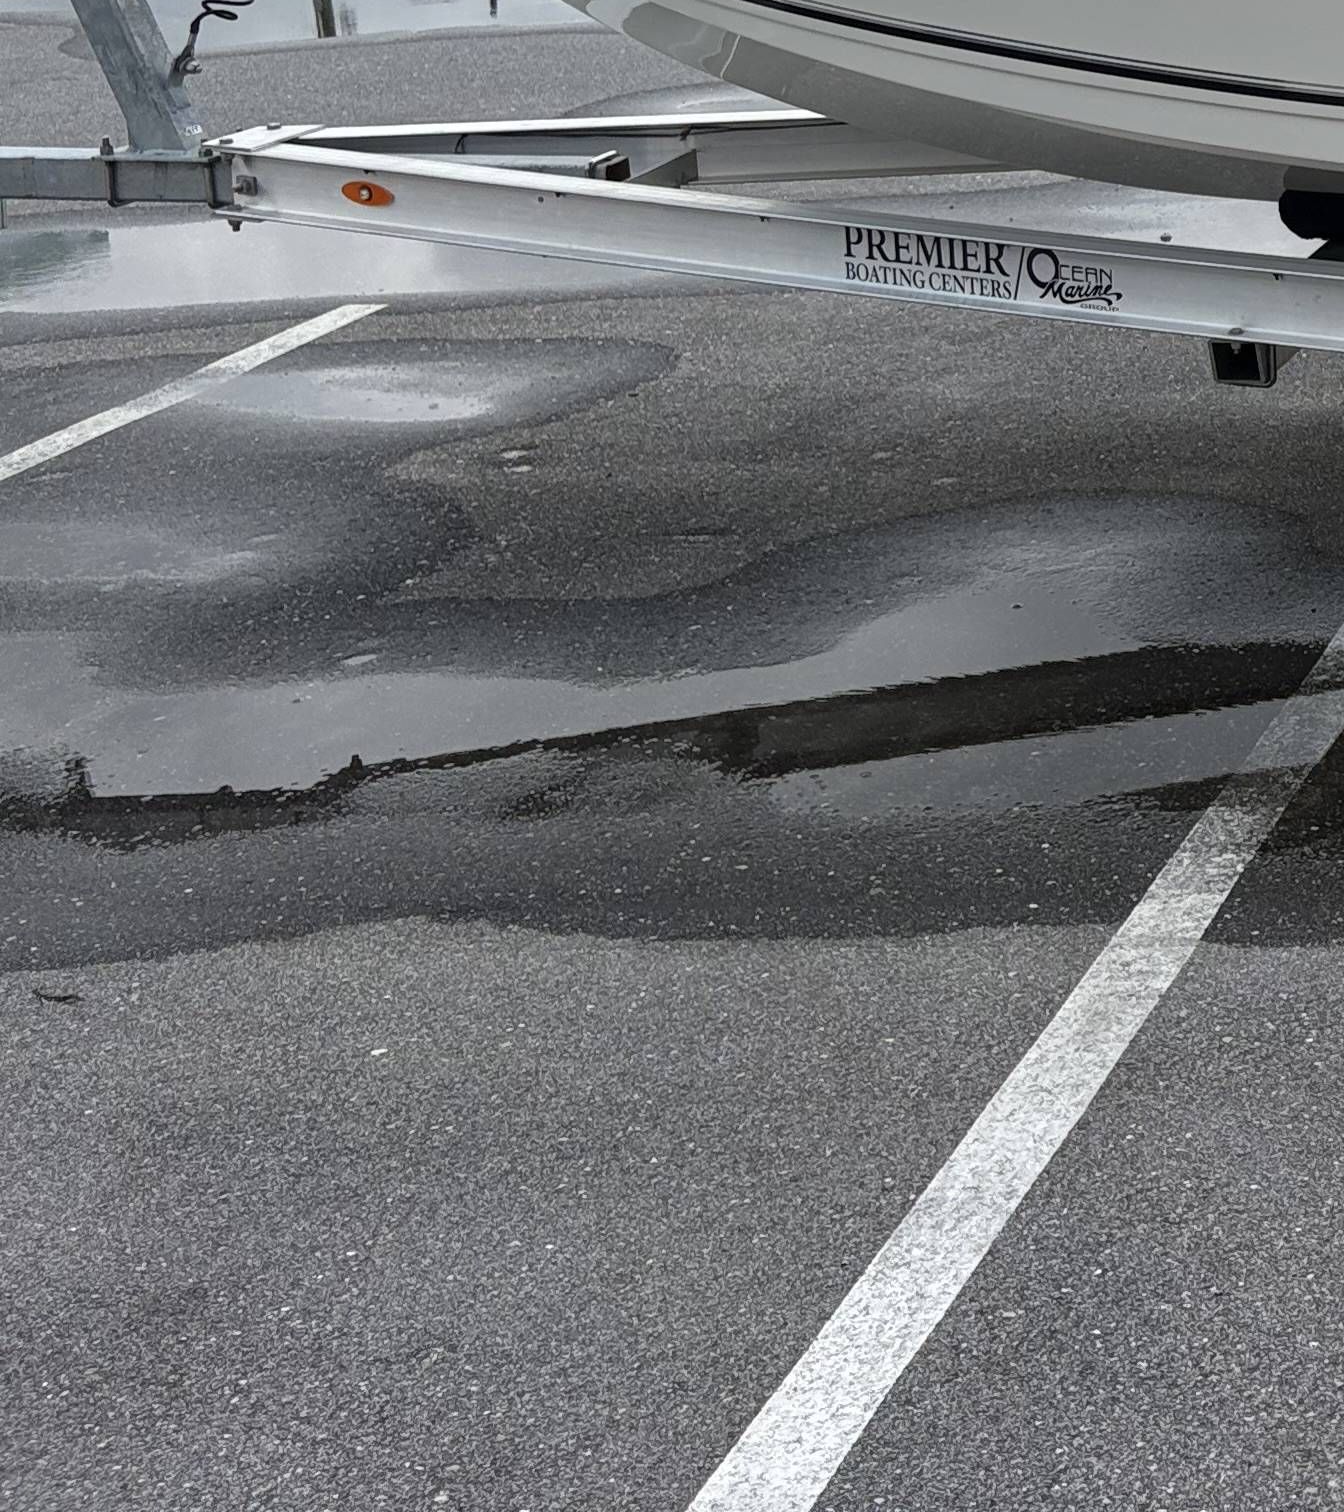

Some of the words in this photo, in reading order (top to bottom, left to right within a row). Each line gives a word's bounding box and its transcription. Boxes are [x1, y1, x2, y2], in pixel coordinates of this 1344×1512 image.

[844, 226, 1011, 277] PREMIER
[845, 261, 925, 289] BOATING
[928, 271, 1012, 300] CENTERS
[1040, 279, 1123, 305] Marine
